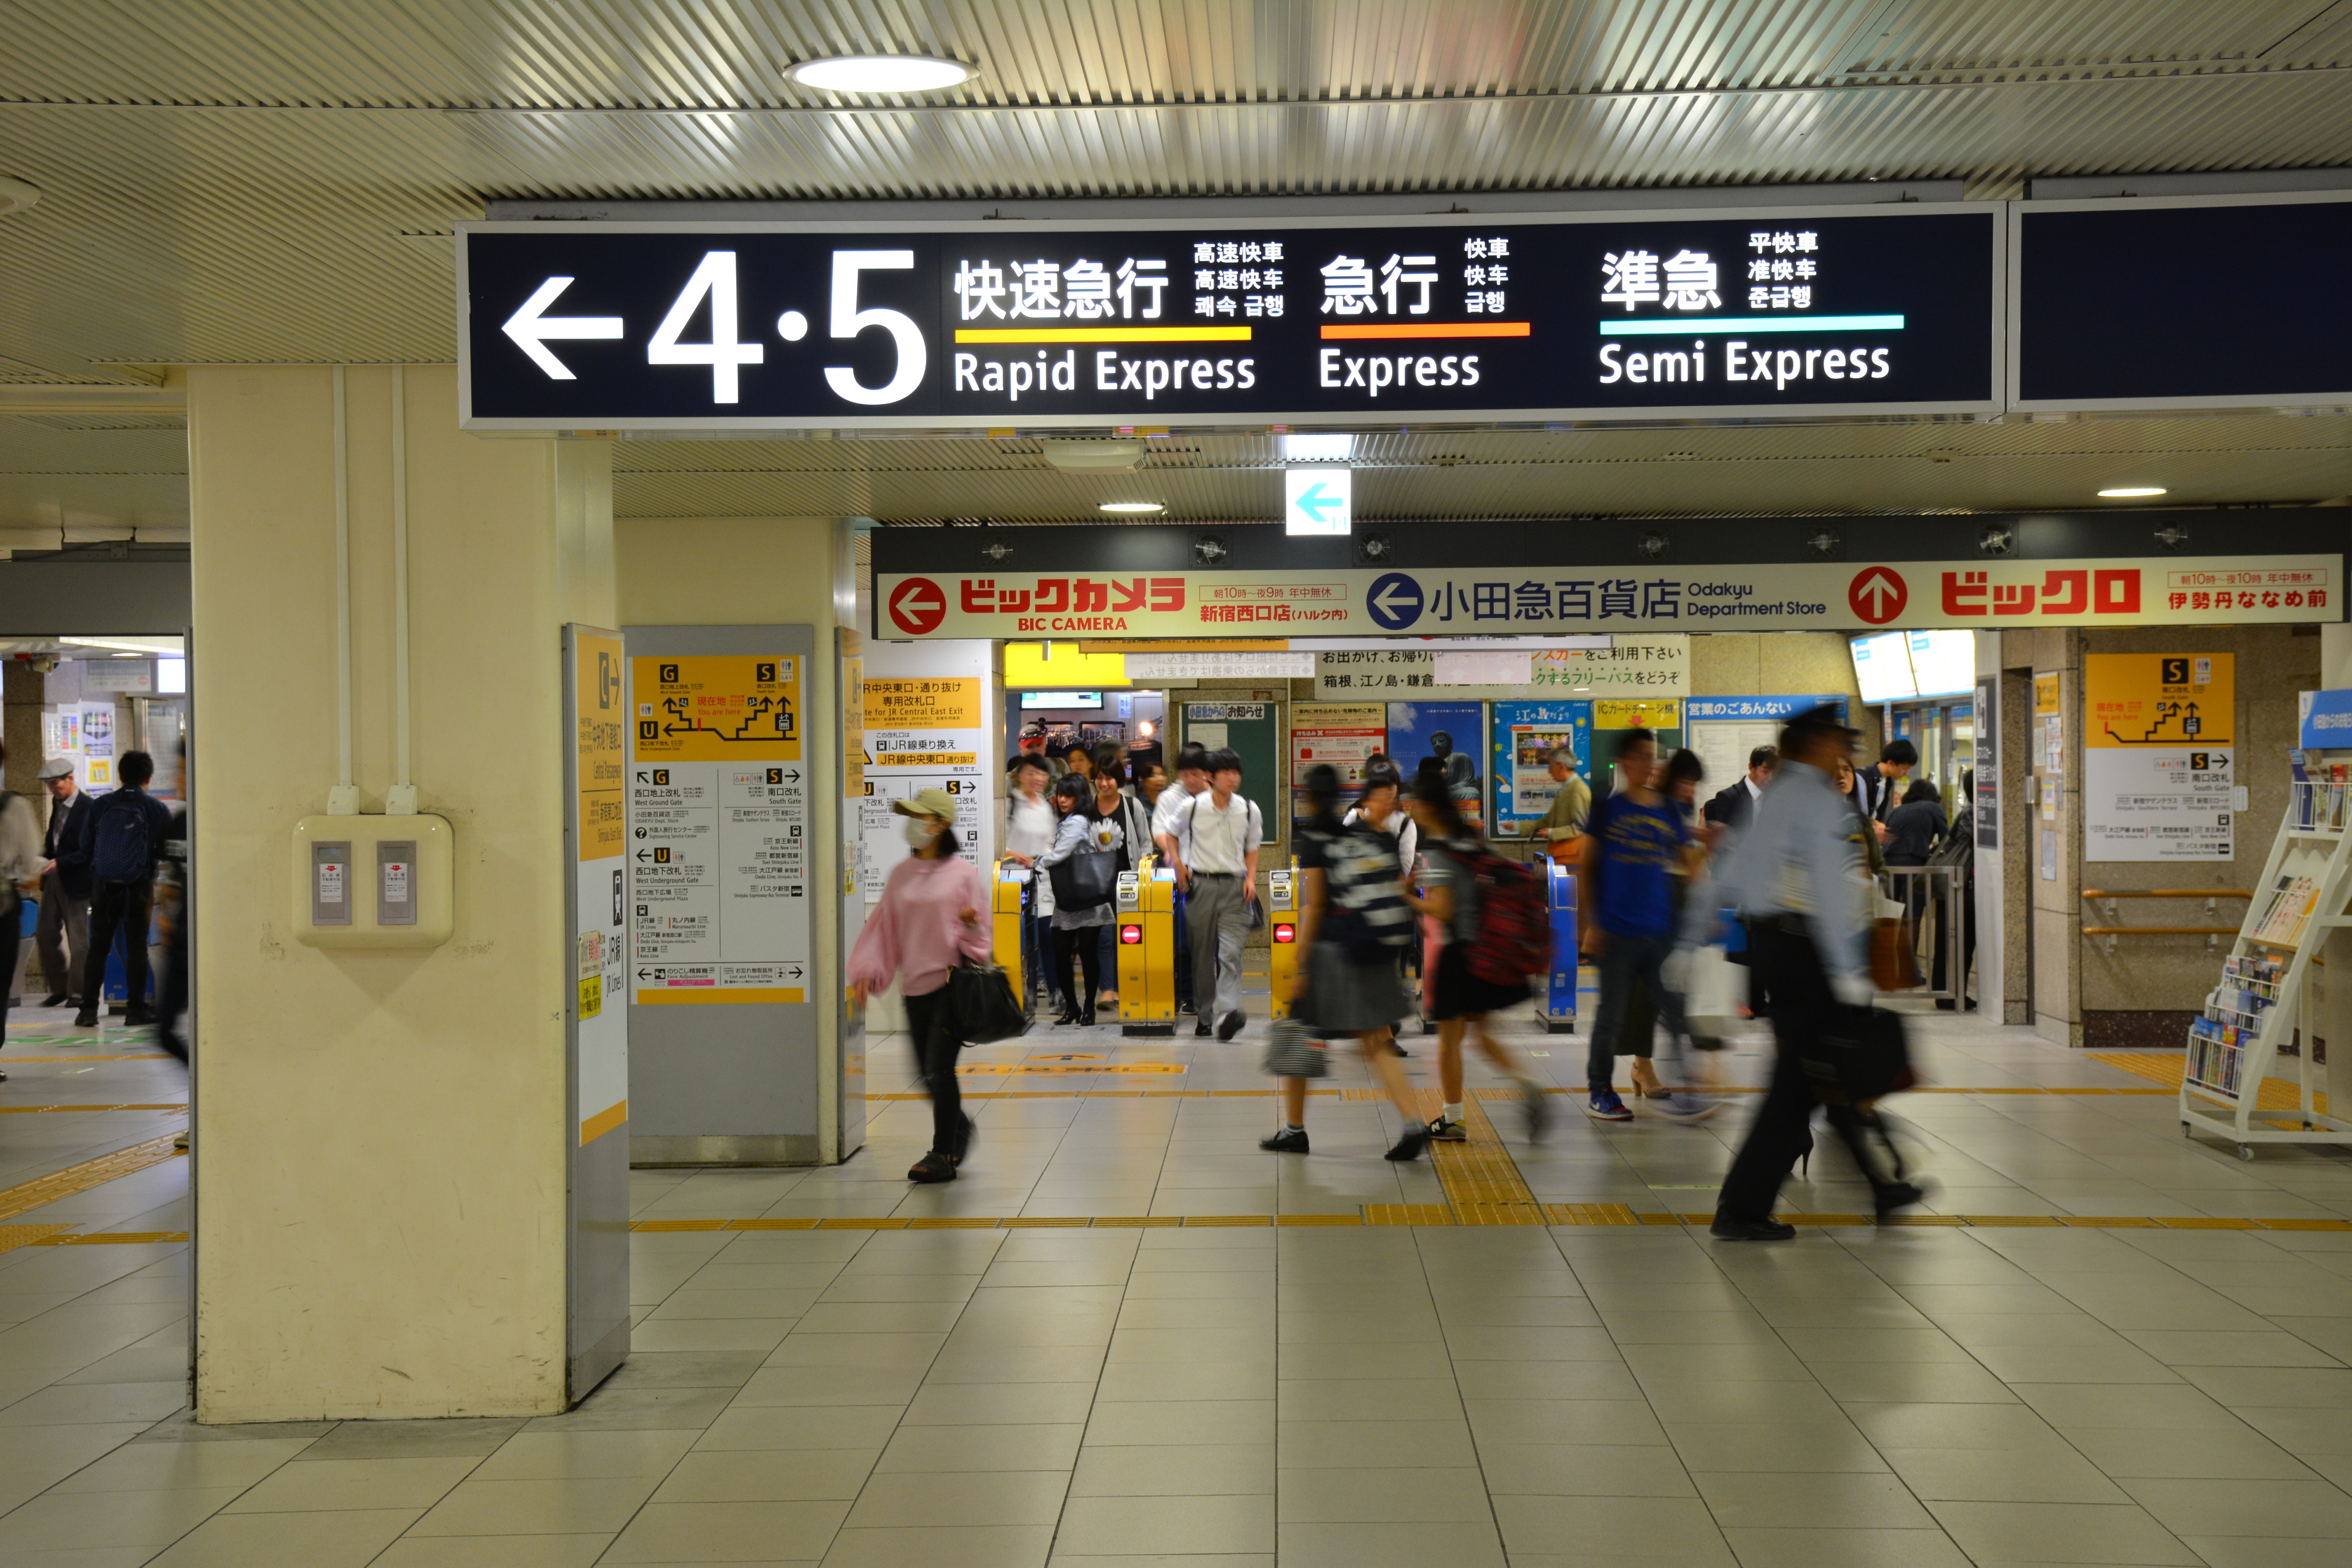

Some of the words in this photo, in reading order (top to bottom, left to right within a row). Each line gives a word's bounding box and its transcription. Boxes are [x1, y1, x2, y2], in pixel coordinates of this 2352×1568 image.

[1464, 238, 1509, 259] 快車
[1748, 231, 1818, 253] 平快車
[1194, 242, 1284, 263] 高速快車
[1464, 264, 1508, 286] 快车
[1748, 258, 1817, 281] 准快车
[1195, 269, 1284, 290] 高速快车
[1320, 254, 1438, 315] 急行
[1601, 250, 1722, 311] 準急
[954, 258, 1168, 320] 快速急行
[1465, 291, 1505, 313] 급행
[1748, 286, 1811, 308] 준급행
[1195, 296, 1237, 317] 쾌속
[1244, 294, 1284, 317] 급행
[1600, 340, 1705, 383] Semi
[1726, 342, 1890, 390] Express
[955, 350, 1074, 401] Rapid
[1097, 351, 1255, 400] Express
[1320, 348, 1480, 397] Express
[2267, 573, 2313, 585] 年中無休
[961, 578, 1185, 613] ビックカメラ
[1289, 586, 1332, 598] 年中無休
[1687, 582, 1753, 600] Odakyu
[1430, 579, 1681, 621] 小田急百貨店
[2168, 589, 2328, 610] 伊勢丹ななめ前
[1687, 602, 1784, 619] Department
[1787, 601, 1826, 615] Store
[1018, 618, 1047, 631] BIC
[1051, 617, 1128, 631] CAMERA
[664, 666, 675, 681] G
[762, 666, 770, 680] S
[2169, 661, 2182, 681] S
[697, 696, 726, 706] 現在地
[882, 696, 935, 707] 専用改札口
[889, 708, 897, 716] JR
[900, 707, 927, 716] Central
[1227, 706, 1263, 719] お知らせ
[1597, 703, 1674, 716] ICカードチャージ機
[1688, 702, 1792, 716] 営業のごあんない
[644, 724, 654, 737] U
[892, 740, 956, 751] JR線乗り換え
[881, 755, 945, 765] JR線中央東口
[2195, 755, 2204, 769] S
[656, 771, 666, 784] G
[771, 770, 779, 783] S
[2192, 773, 2230, 782] 南口改札
[635, 788, 681, 797] 西口地上改札
[768, 788, 802, 796] 南口改札
[949, 782, 957, 793] S
[658, 849, 667, 862] U
[636, 867, 682, 876] 西口地下改札
